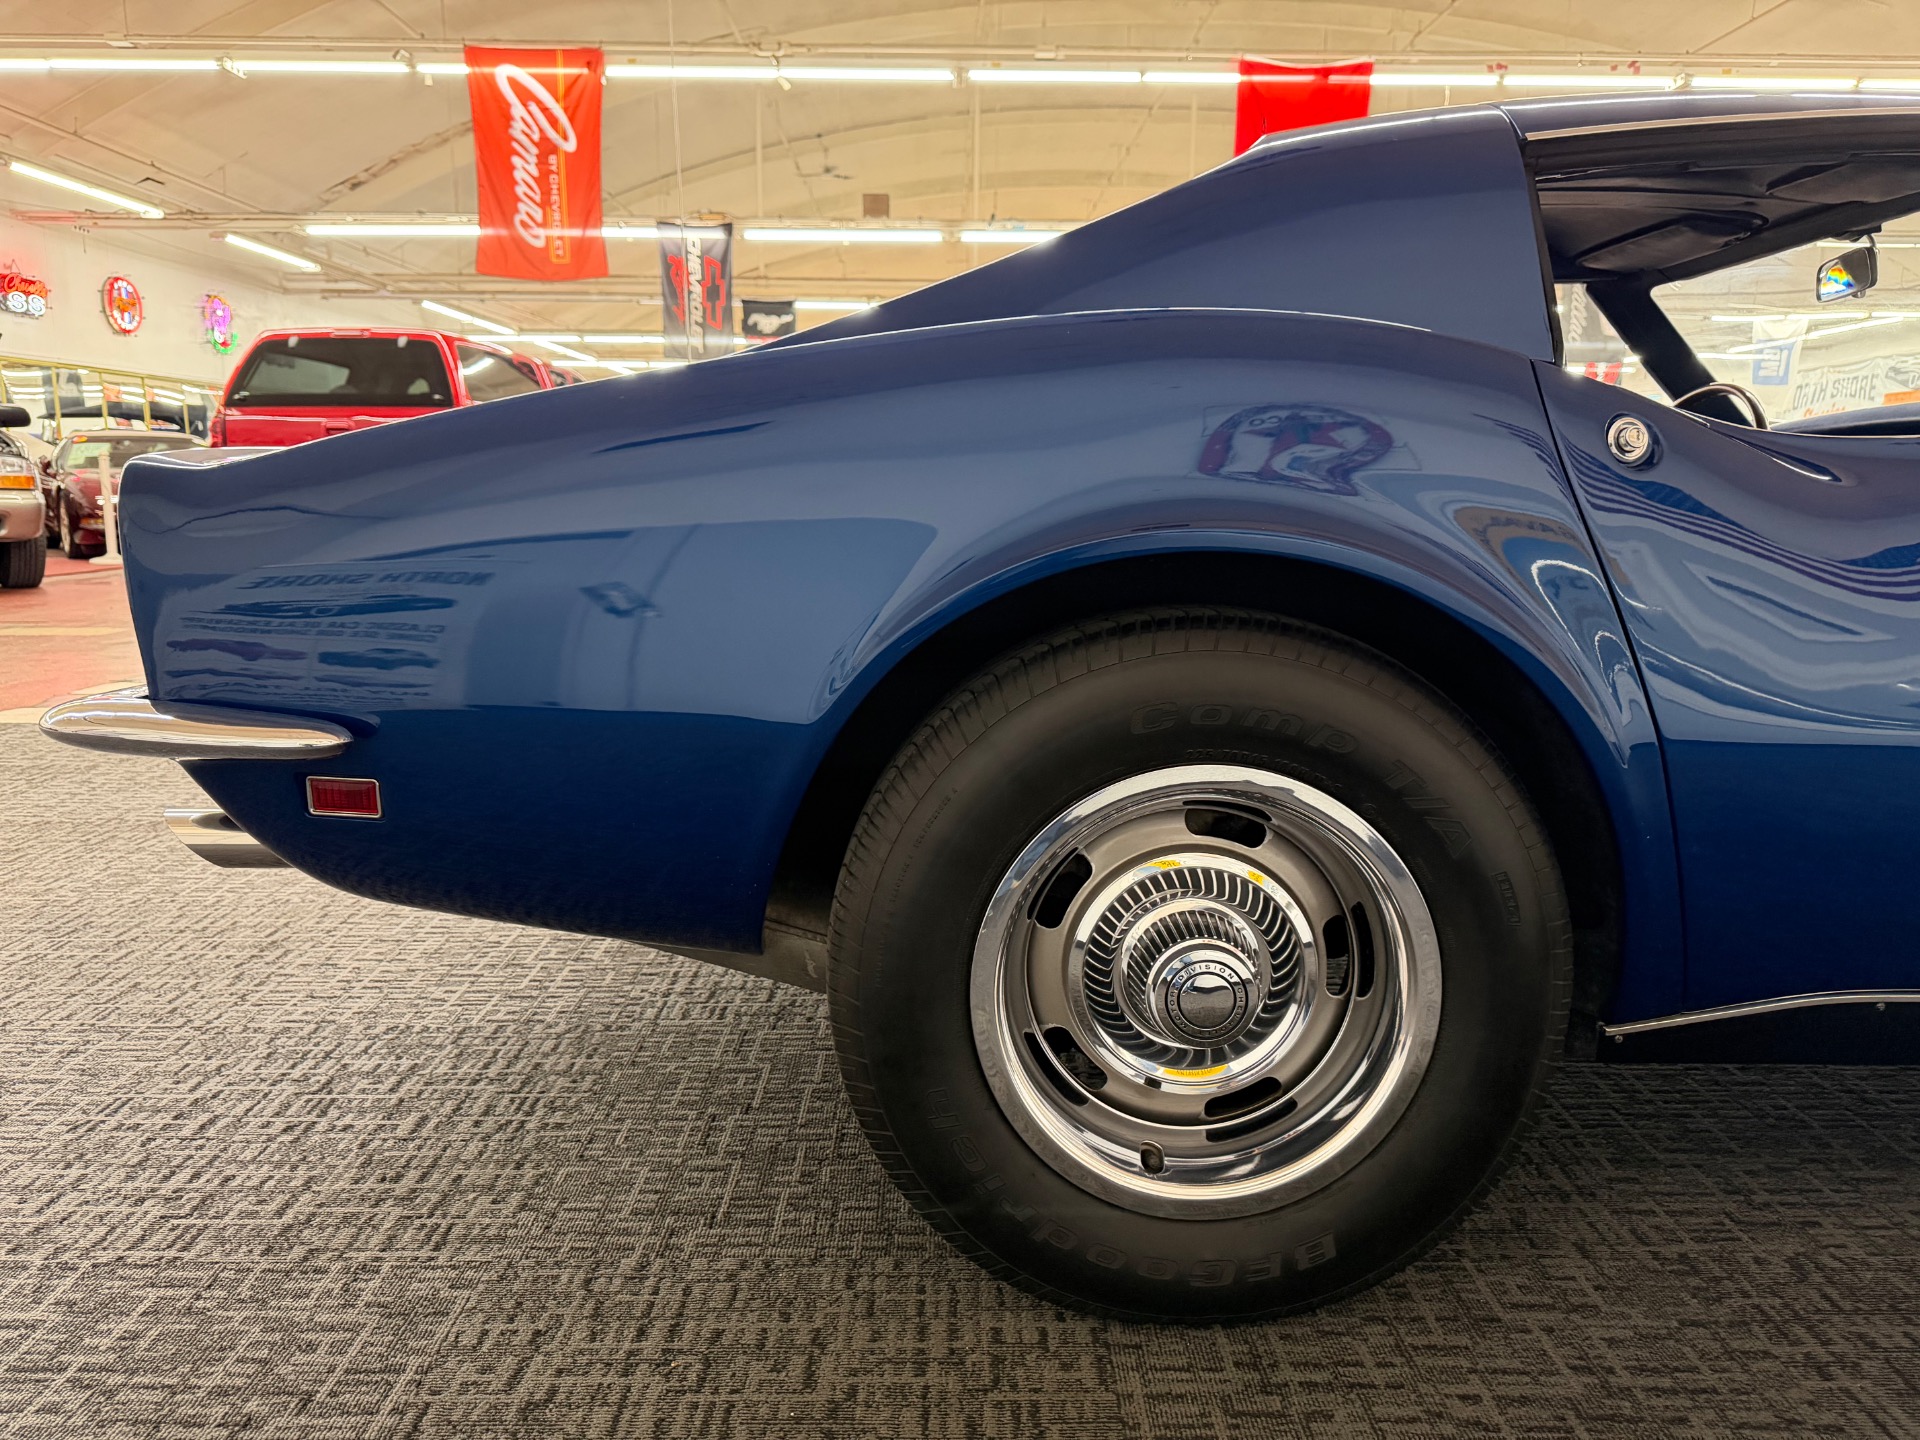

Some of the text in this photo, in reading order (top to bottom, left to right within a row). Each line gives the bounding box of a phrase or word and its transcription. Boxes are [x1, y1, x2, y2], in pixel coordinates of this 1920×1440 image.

[495, 63, 578, 248] Camaro
[548, 154, 565, 257] BY CHEVROLET
[7, 290, 46, 317] SS
[686, 237, 704, 354] CHEVROLET
[1792, 380, 1829, 411] ORTH
[1830, 373, 1879, 402] SHORE
[1129, 699, 1358, 761] Comp
[1381, 775, 1473, 860] T/A
[1178, 963, 1236, 982] DIVISION
[925, 1089, 1338, 1289] BFGoodrich
